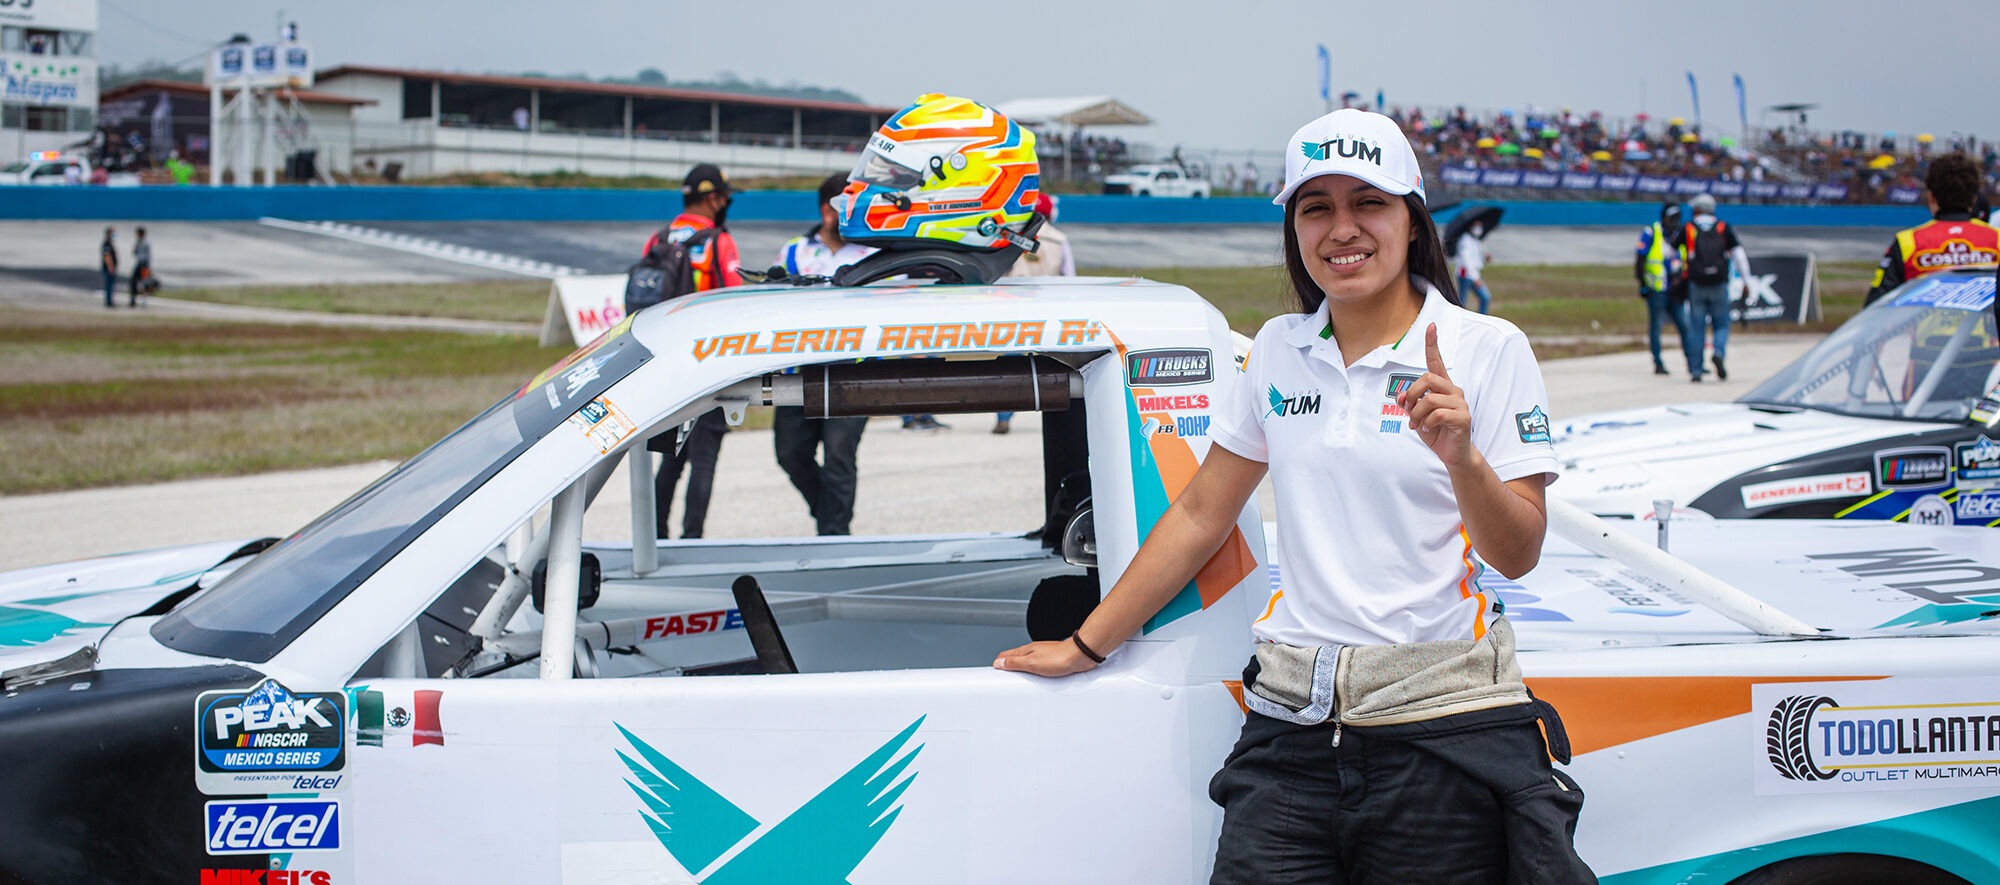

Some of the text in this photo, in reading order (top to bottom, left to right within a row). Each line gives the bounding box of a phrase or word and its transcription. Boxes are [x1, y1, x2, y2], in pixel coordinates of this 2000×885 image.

[1322, 133, 1378, 147] GRUPO
[1319, 138, 1381, 166] TUM
[1948, 242, 1968, 254] La
[691, 325, 867, 363] VALERIA
[878, 319, 1047, 351] ARANDA
[1158, 355, 1208, 370] TRUCKS
[1139, 394, 1209, 411] MIKEL'S
[1281, 394, 1321, 417] TUM
[1158, 415, 1210, 437] FB BOHN
[1380, 420, 1401, 433] BOHN
[1750, 486, 1811, 500] GENERAL
[1960, 494, 2000, 516] telce
[214, 697, 333, 740] PEAK
[253, 733, 309, 748] NASCAR
[1818, 715, 2000, 757] TODOLLANTA
[224, 751, 322, 766] MEXICO SERIES
[292, 774, 343, 789] telcel
[1841, 766, 2000, 782] OUTLET MULTIMAR
[210, 804, 337, 848] telcel
